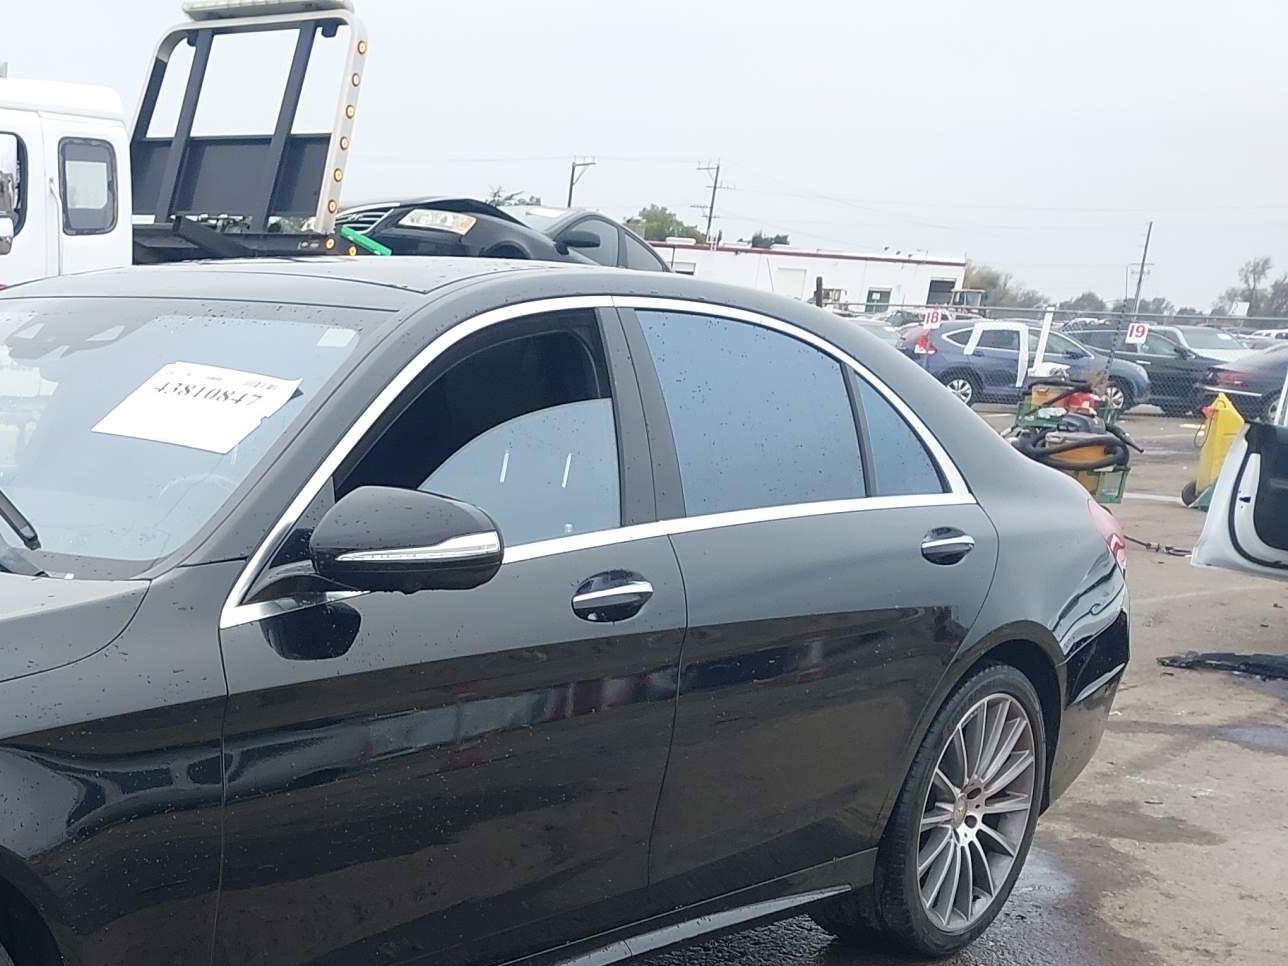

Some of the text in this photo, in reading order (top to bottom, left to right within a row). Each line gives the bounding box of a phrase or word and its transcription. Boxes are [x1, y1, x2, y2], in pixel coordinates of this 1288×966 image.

[925, 311, 940, 324] 18
[1128, 324, 1146, 338] 19
[153, 381, 264, 406] 43810847
